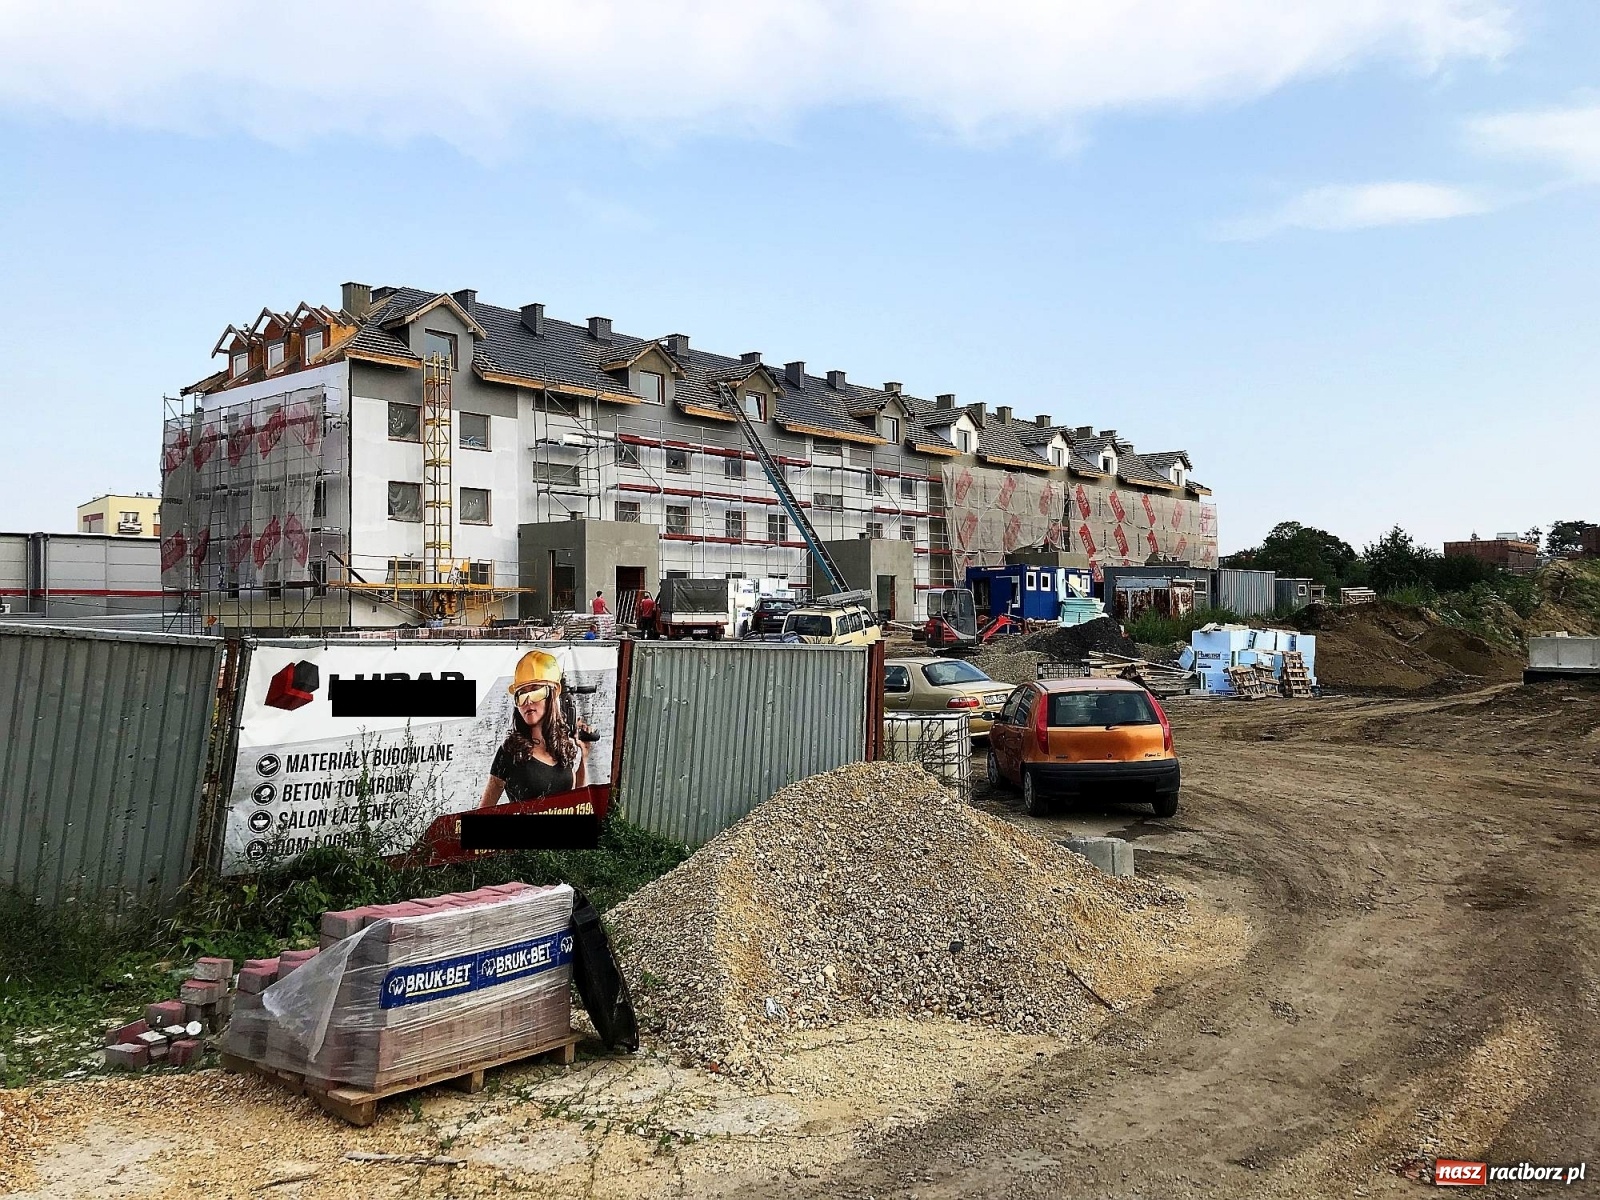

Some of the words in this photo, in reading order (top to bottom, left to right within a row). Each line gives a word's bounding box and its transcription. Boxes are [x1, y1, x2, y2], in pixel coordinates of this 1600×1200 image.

[286, 750, 370, 773] MATERIAŁY
[373, 744, 454, 767] BUDOWLANE
[282, 781, 332, 802] BETON
[278, 809, 328, 830] SALON
[332, 801, 399, 825] ŁAZENEK
[405, 963, 472, 993] BRUK-BET
[496, 943, 552, 973] BRUK-BET
